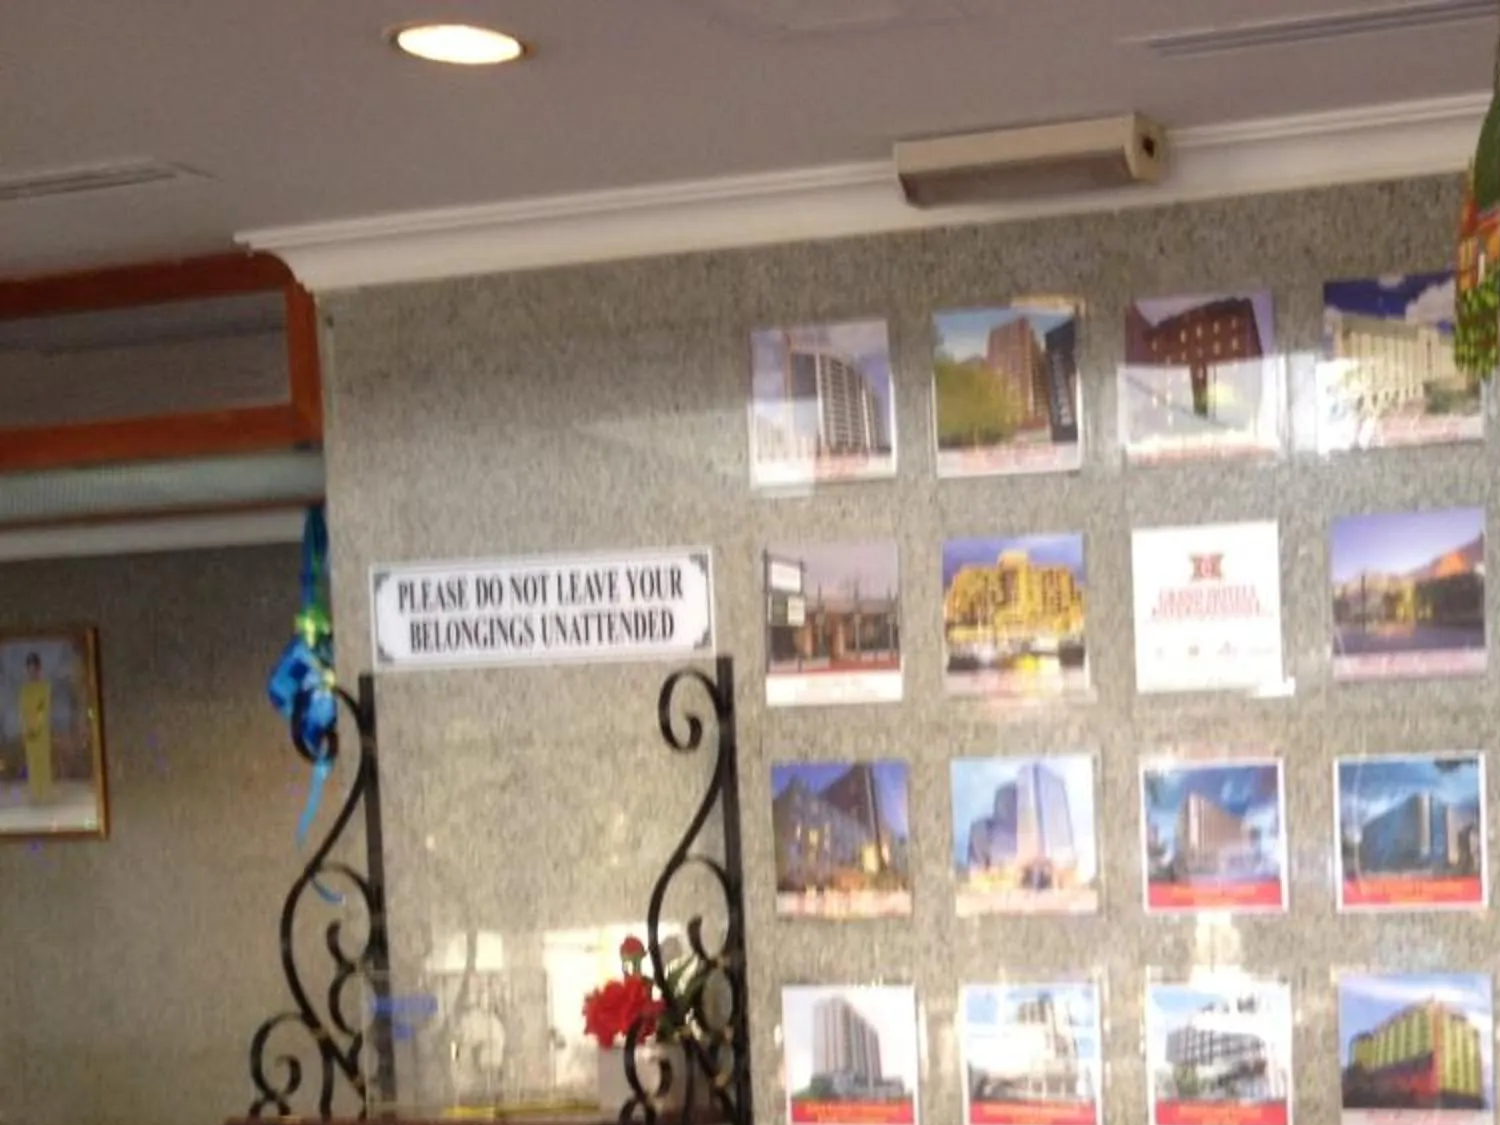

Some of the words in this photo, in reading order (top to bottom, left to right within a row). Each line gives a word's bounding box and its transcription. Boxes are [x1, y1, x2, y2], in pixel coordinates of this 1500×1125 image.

[397, 576, 469, 613] PLEASE
[475, 576, 503, 608] DO
[510, 572, 549, 606] NOT
[557, 568, 620, 605] LEAVE
[626, 565, 684, 600] YOUR
[410, 614, 535, 654] BELONGINGS
[541, 608, 675, 648] UNATTENDED
